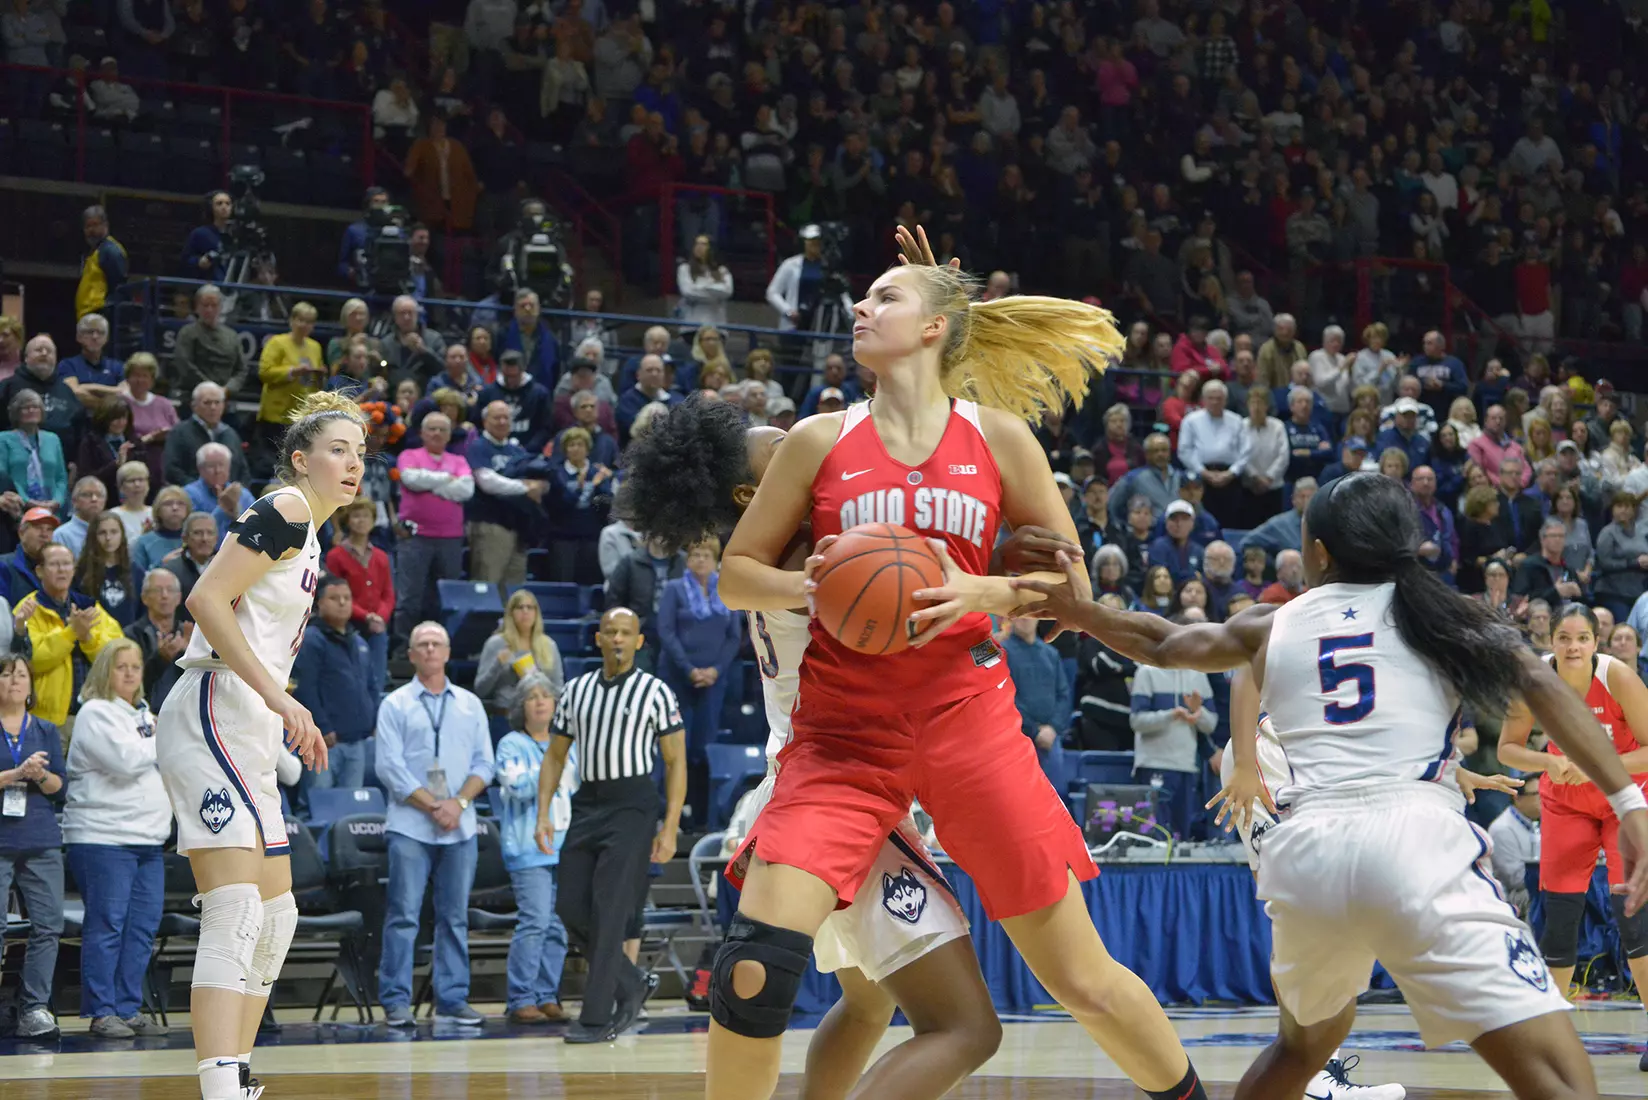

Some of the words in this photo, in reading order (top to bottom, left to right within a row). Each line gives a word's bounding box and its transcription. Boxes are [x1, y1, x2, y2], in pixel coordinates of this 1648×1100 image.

[841, 487, 905, 531] OHIO
[914, 487, 987, 549] STATE
[1318, 632, 1375, 725] 5
[348, 822, 386, 835] UCON
